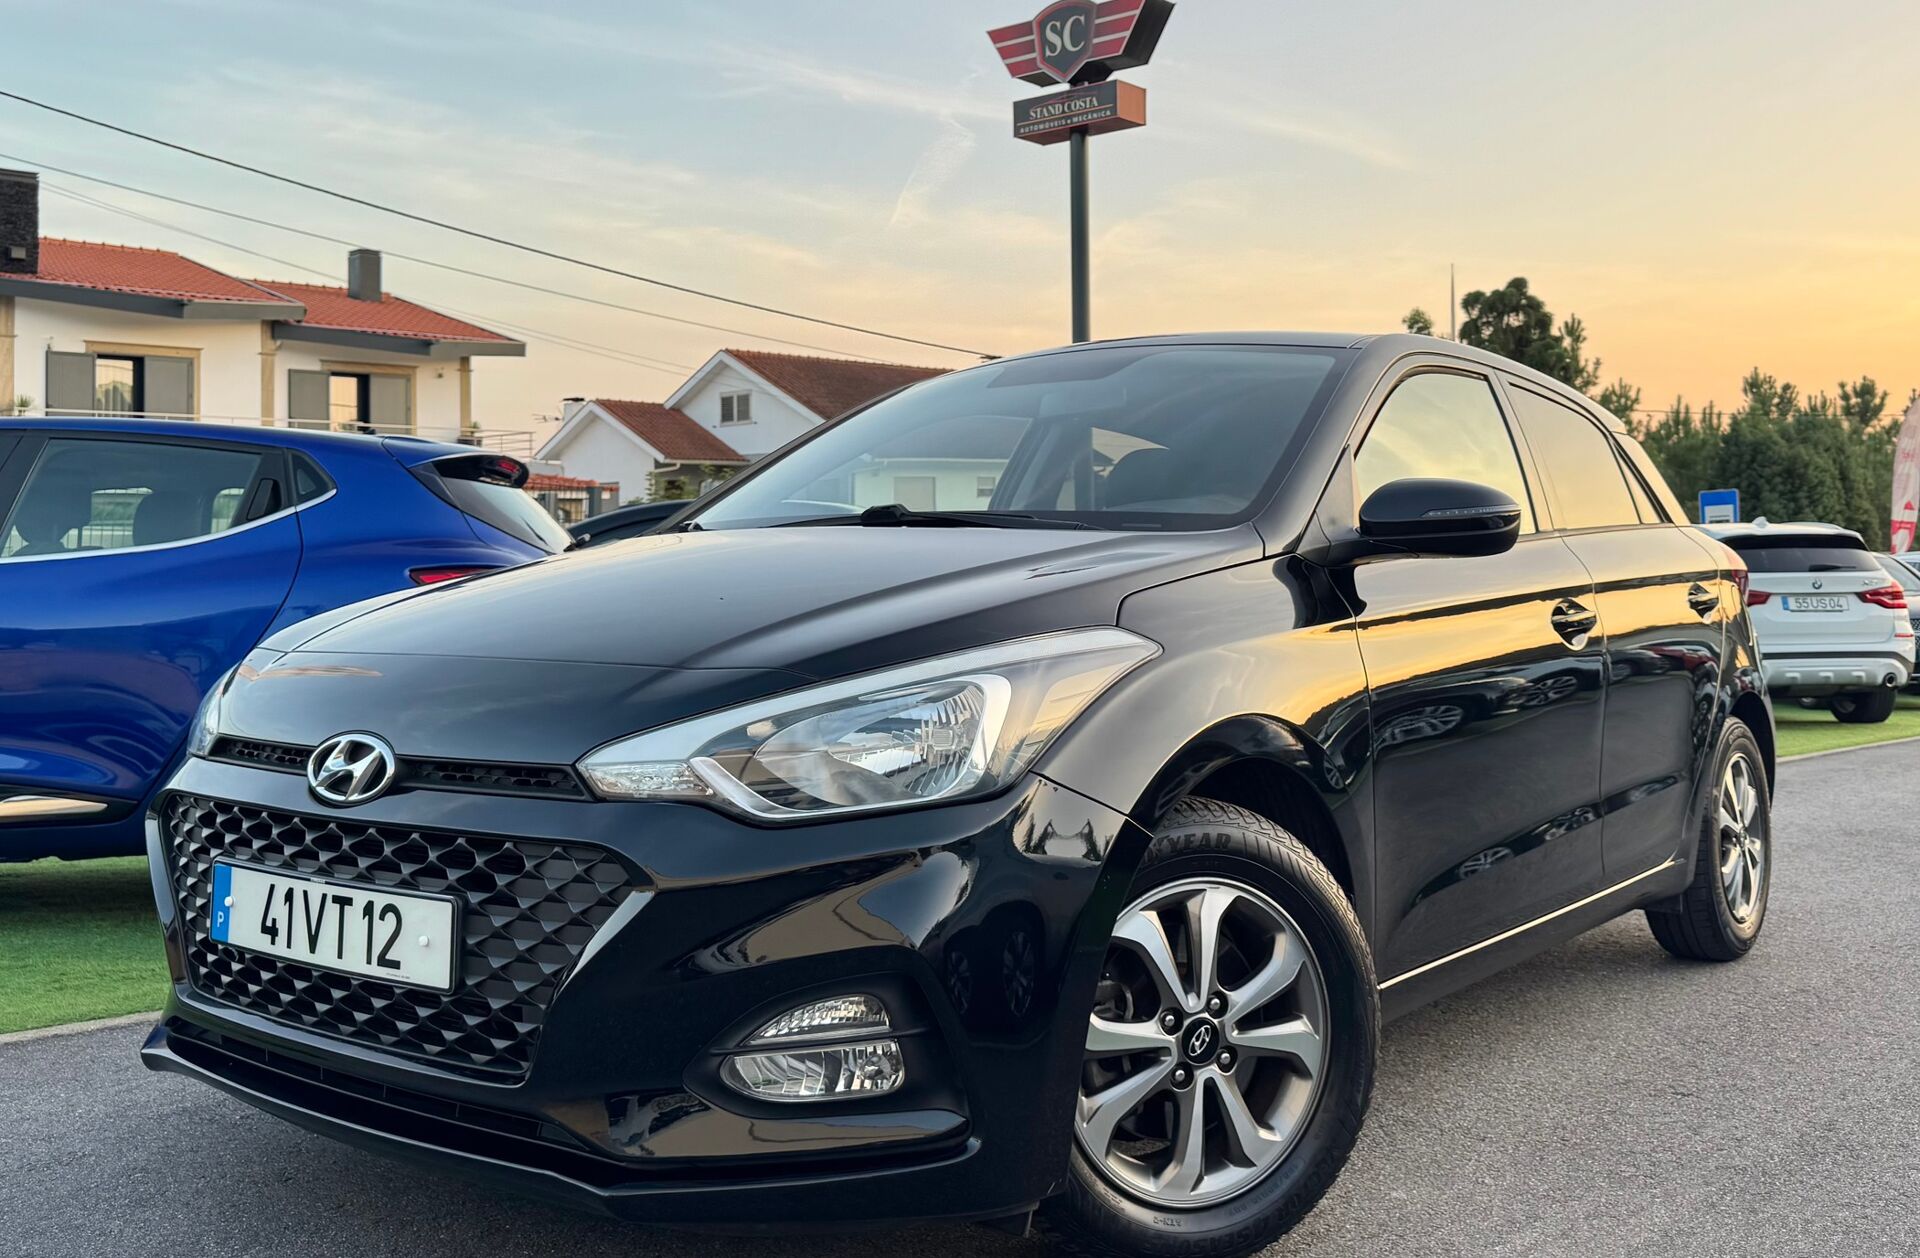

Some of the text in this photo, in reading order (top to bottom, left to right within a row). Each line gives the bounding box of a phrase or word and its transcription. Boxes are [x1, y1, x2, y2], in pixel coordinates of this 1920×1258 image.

[1045, 15, 1085, 57] SC
[1030, 97, 1098, 119] STAND COSTA
[217, 911, 224, 927] P
